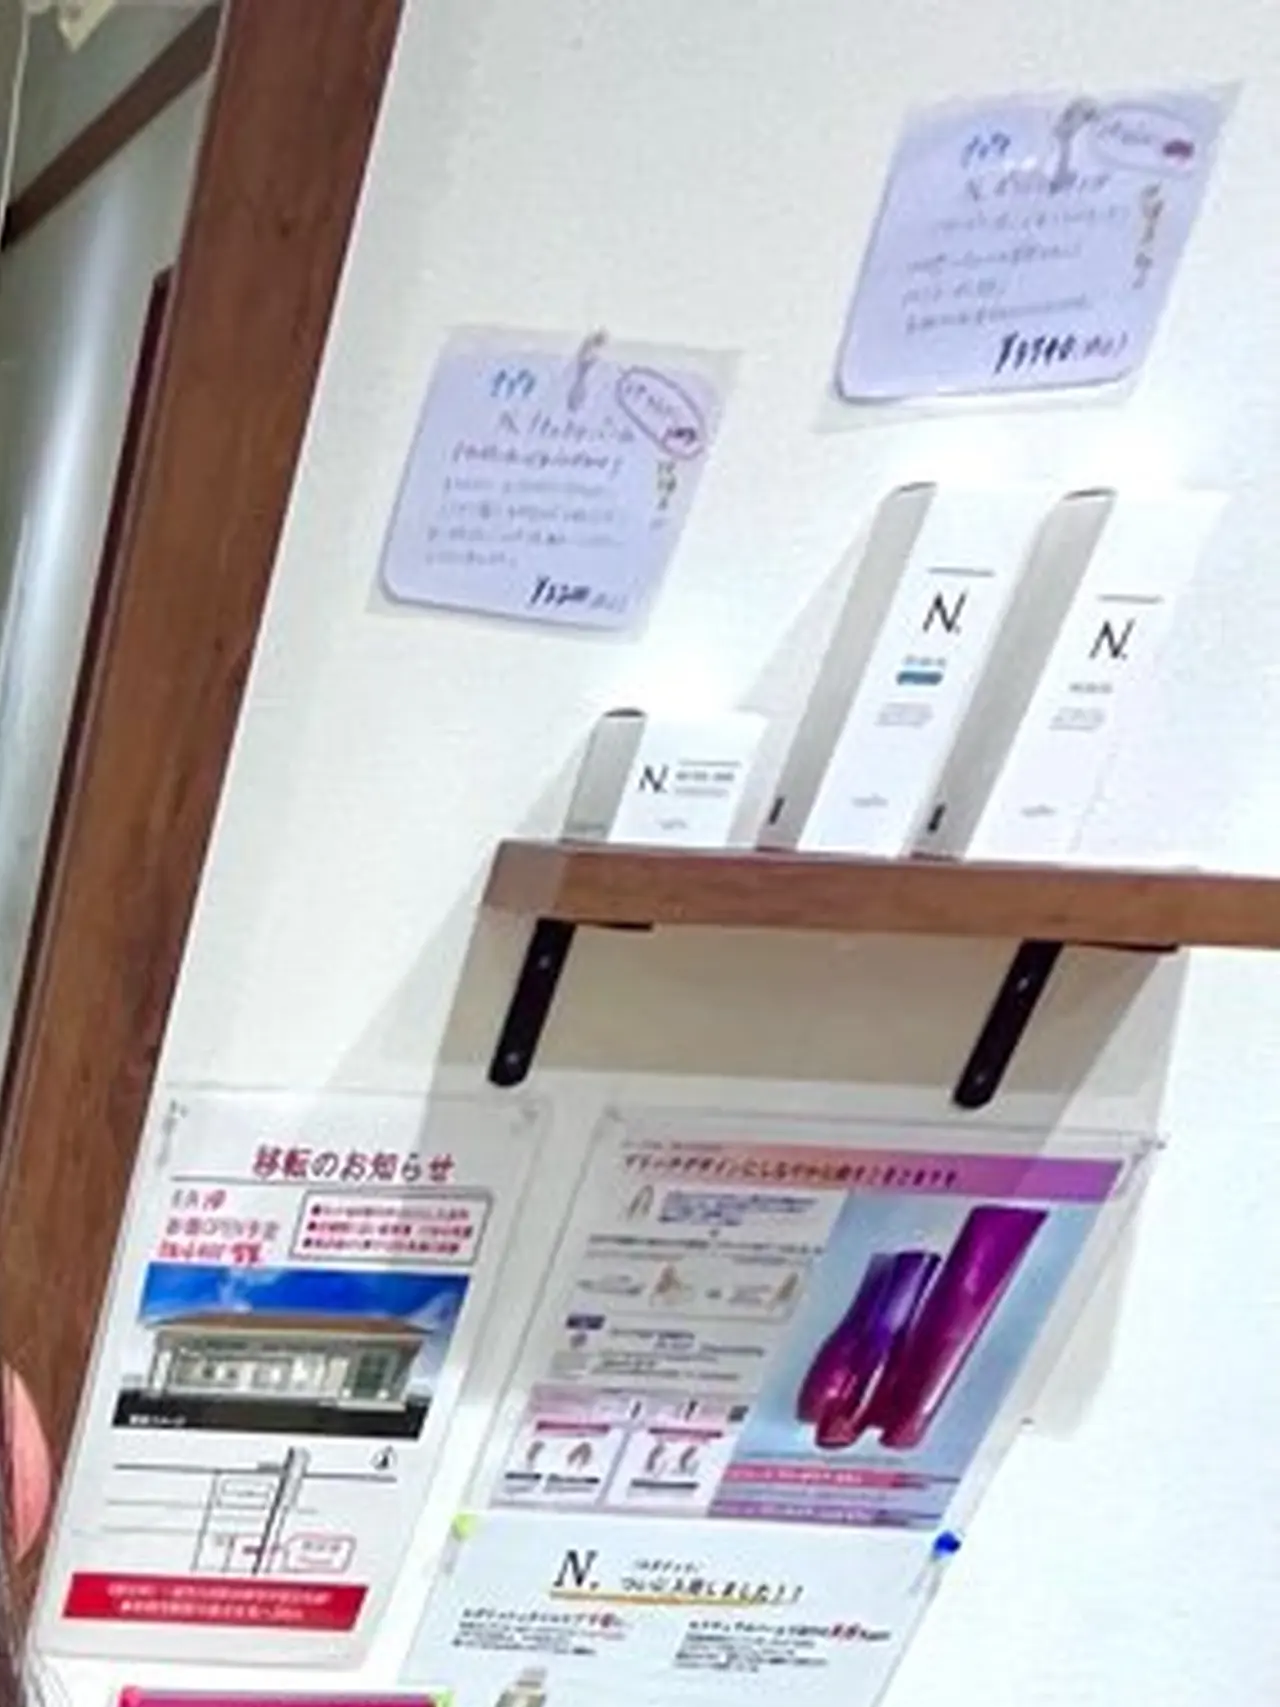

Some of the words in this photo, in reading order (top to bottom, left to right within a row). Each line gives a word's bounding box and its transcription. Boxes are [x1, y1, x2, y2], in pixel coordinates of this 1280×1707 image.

[923, 593, 967, 633] N.
[1090, 620, 1136, 659] N.
[252, 1144, 454, 1182] 移転のお知らせ
[553, 1550, 599, 1590] N.
